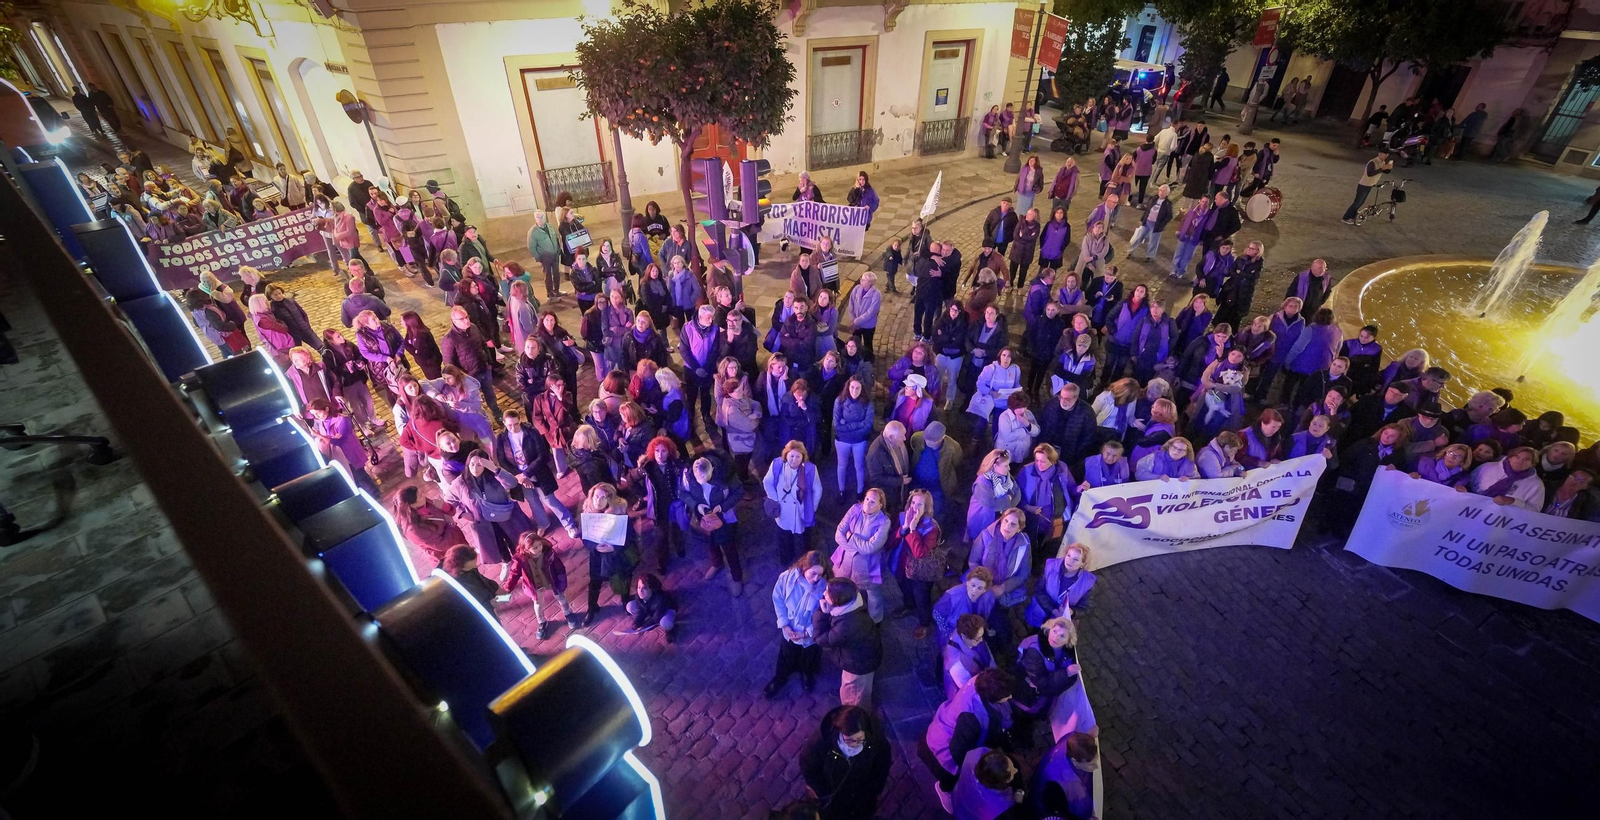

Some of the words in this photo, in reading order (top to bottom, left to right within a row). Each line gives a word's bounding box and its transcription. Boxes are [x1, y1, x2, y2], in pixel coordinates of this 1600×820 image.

[791, 202, 868, 226] TERRORISMO
[159, 249, 213, 268] TODOS
[214, 242, 245, 256] LOS
[246, 223, 318, 248] DERECHO
[160, 236, 212, 255] TODAS
[214, 229, 246, 243] LAS
[248, 210, 313, 235] MUJERES
[783, 218, 840, 245] MACHISTA
[189, 255, 240, 275] TODOS
[242, 247, 272, 262] LOS
[274, 235, 307, 254] DÍAS
[1182, 484, 1253, 499] INTERNACIONAL
[1270, 490, 1292, 498] DE
[1085, 493, 1154, 529] 25
[1391, 512, 1421, 523] ATENEO
[1458, 506, 1483, 519] NI
[1483, 513, 1514, 528] UN
[1442, 530, 1466, 543] NI
[1466, 538, 1496, 555] UN
[1494, 545, 1547, 566] PASO
[1434, 545, 1495, 574] TODAS
[1496, 564, 1569, 592] UNIDAS.
